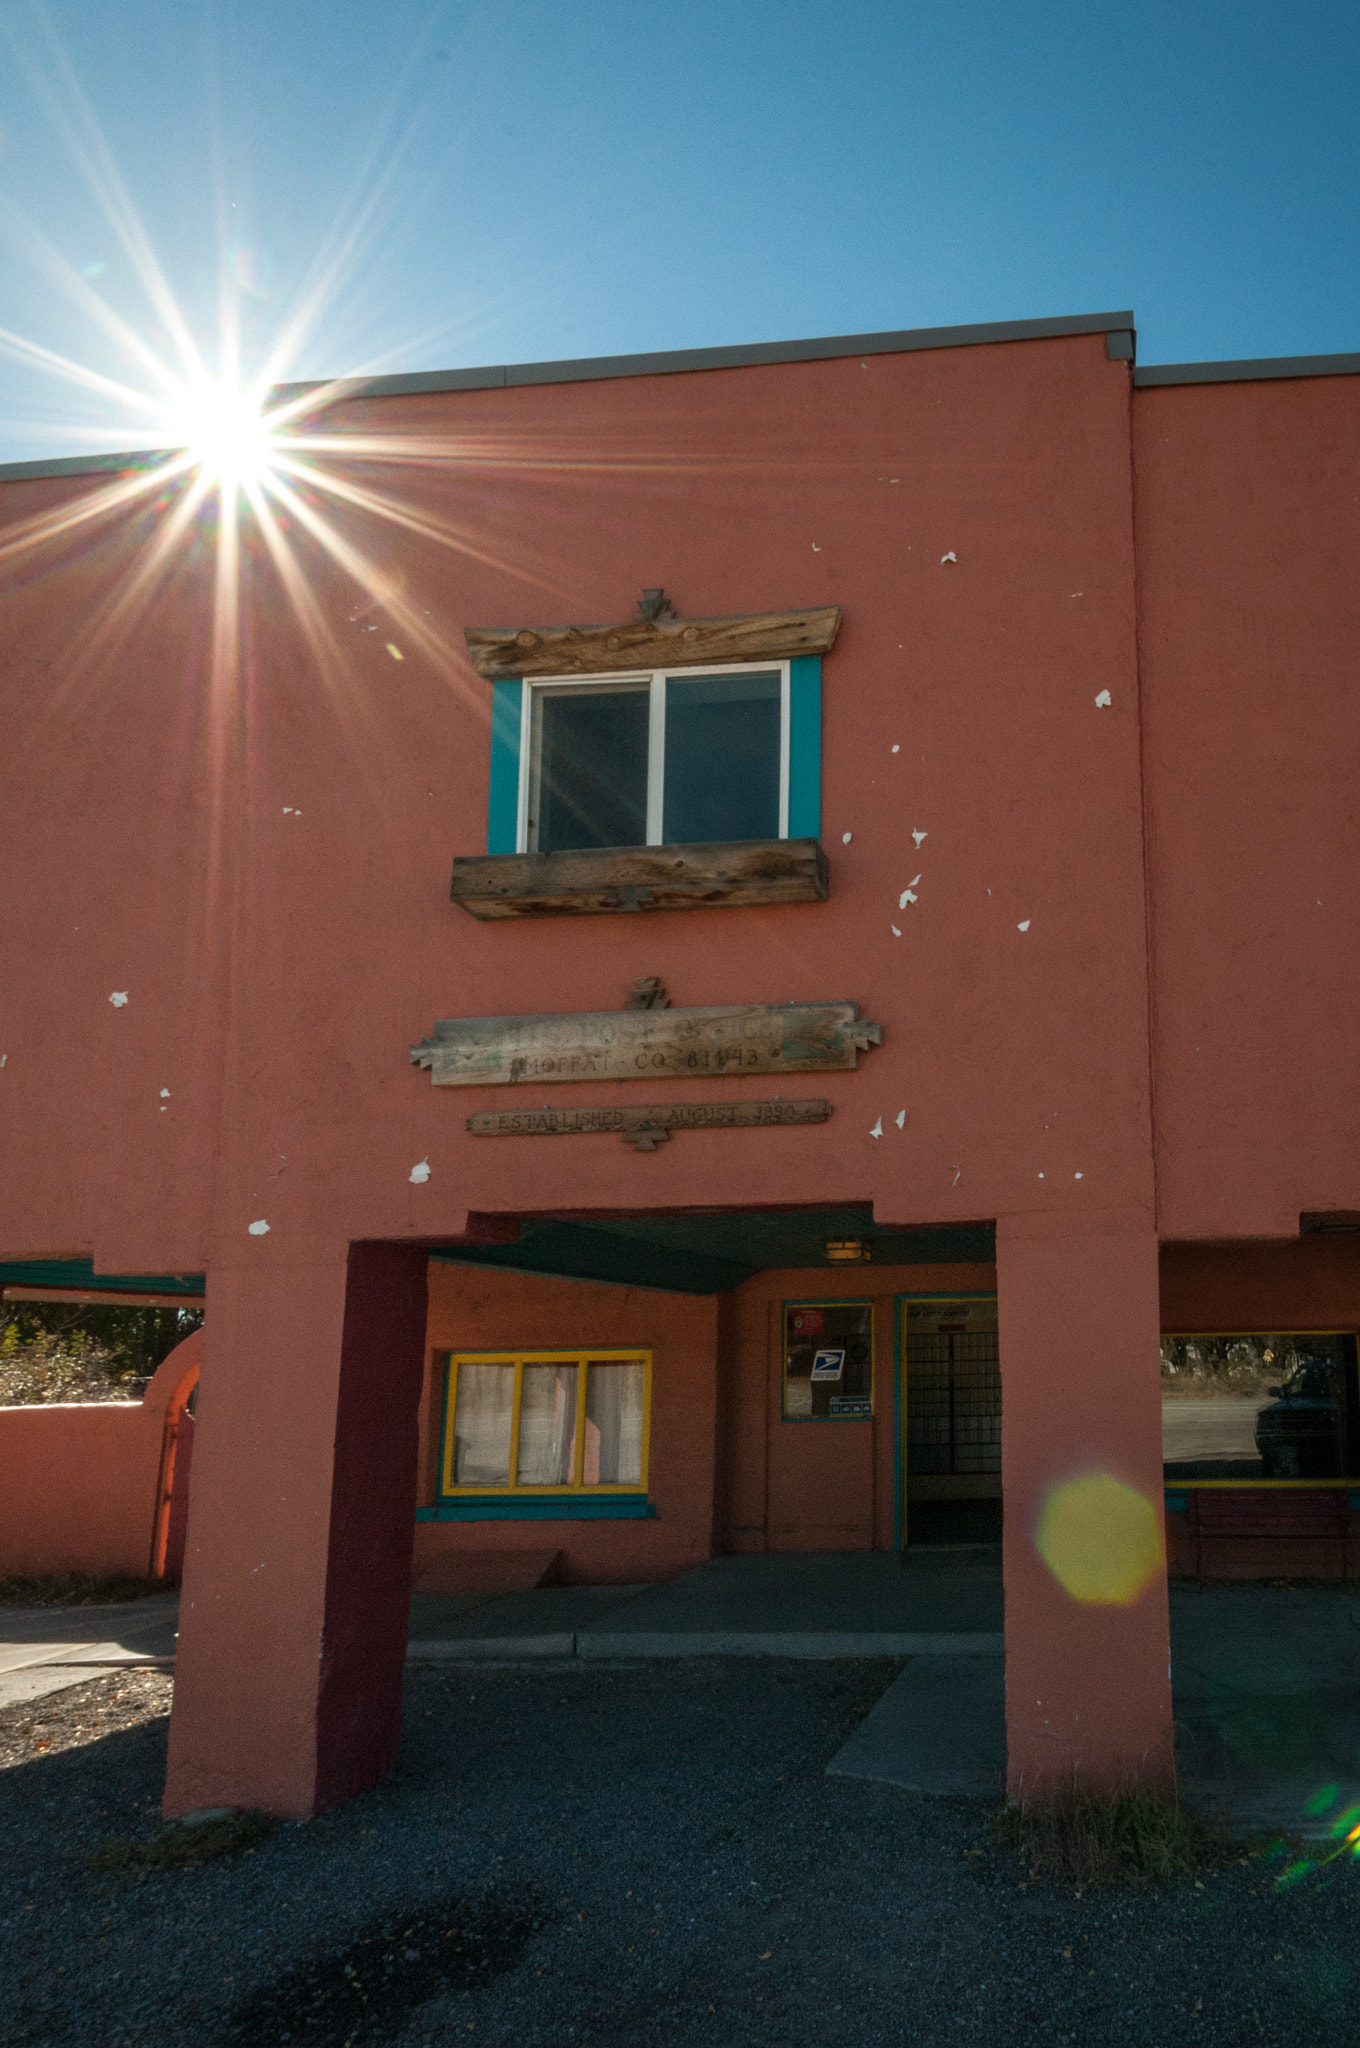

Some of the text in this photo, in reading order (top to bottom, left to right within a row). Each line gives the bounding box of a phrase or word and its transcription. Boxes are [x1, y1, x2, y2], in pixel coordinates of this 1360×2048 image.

[579, 1019, 656, 1046] POST
[674, 1014, 775, 1041] OFFICE
[523, 1055, 612, 1075] MOFFAT
[686, 1047, 759, 1070] 81143
[496, 1111, 626, 1132] ESTABLISHED
[667, 1105, 738, 1125] AUGUST
